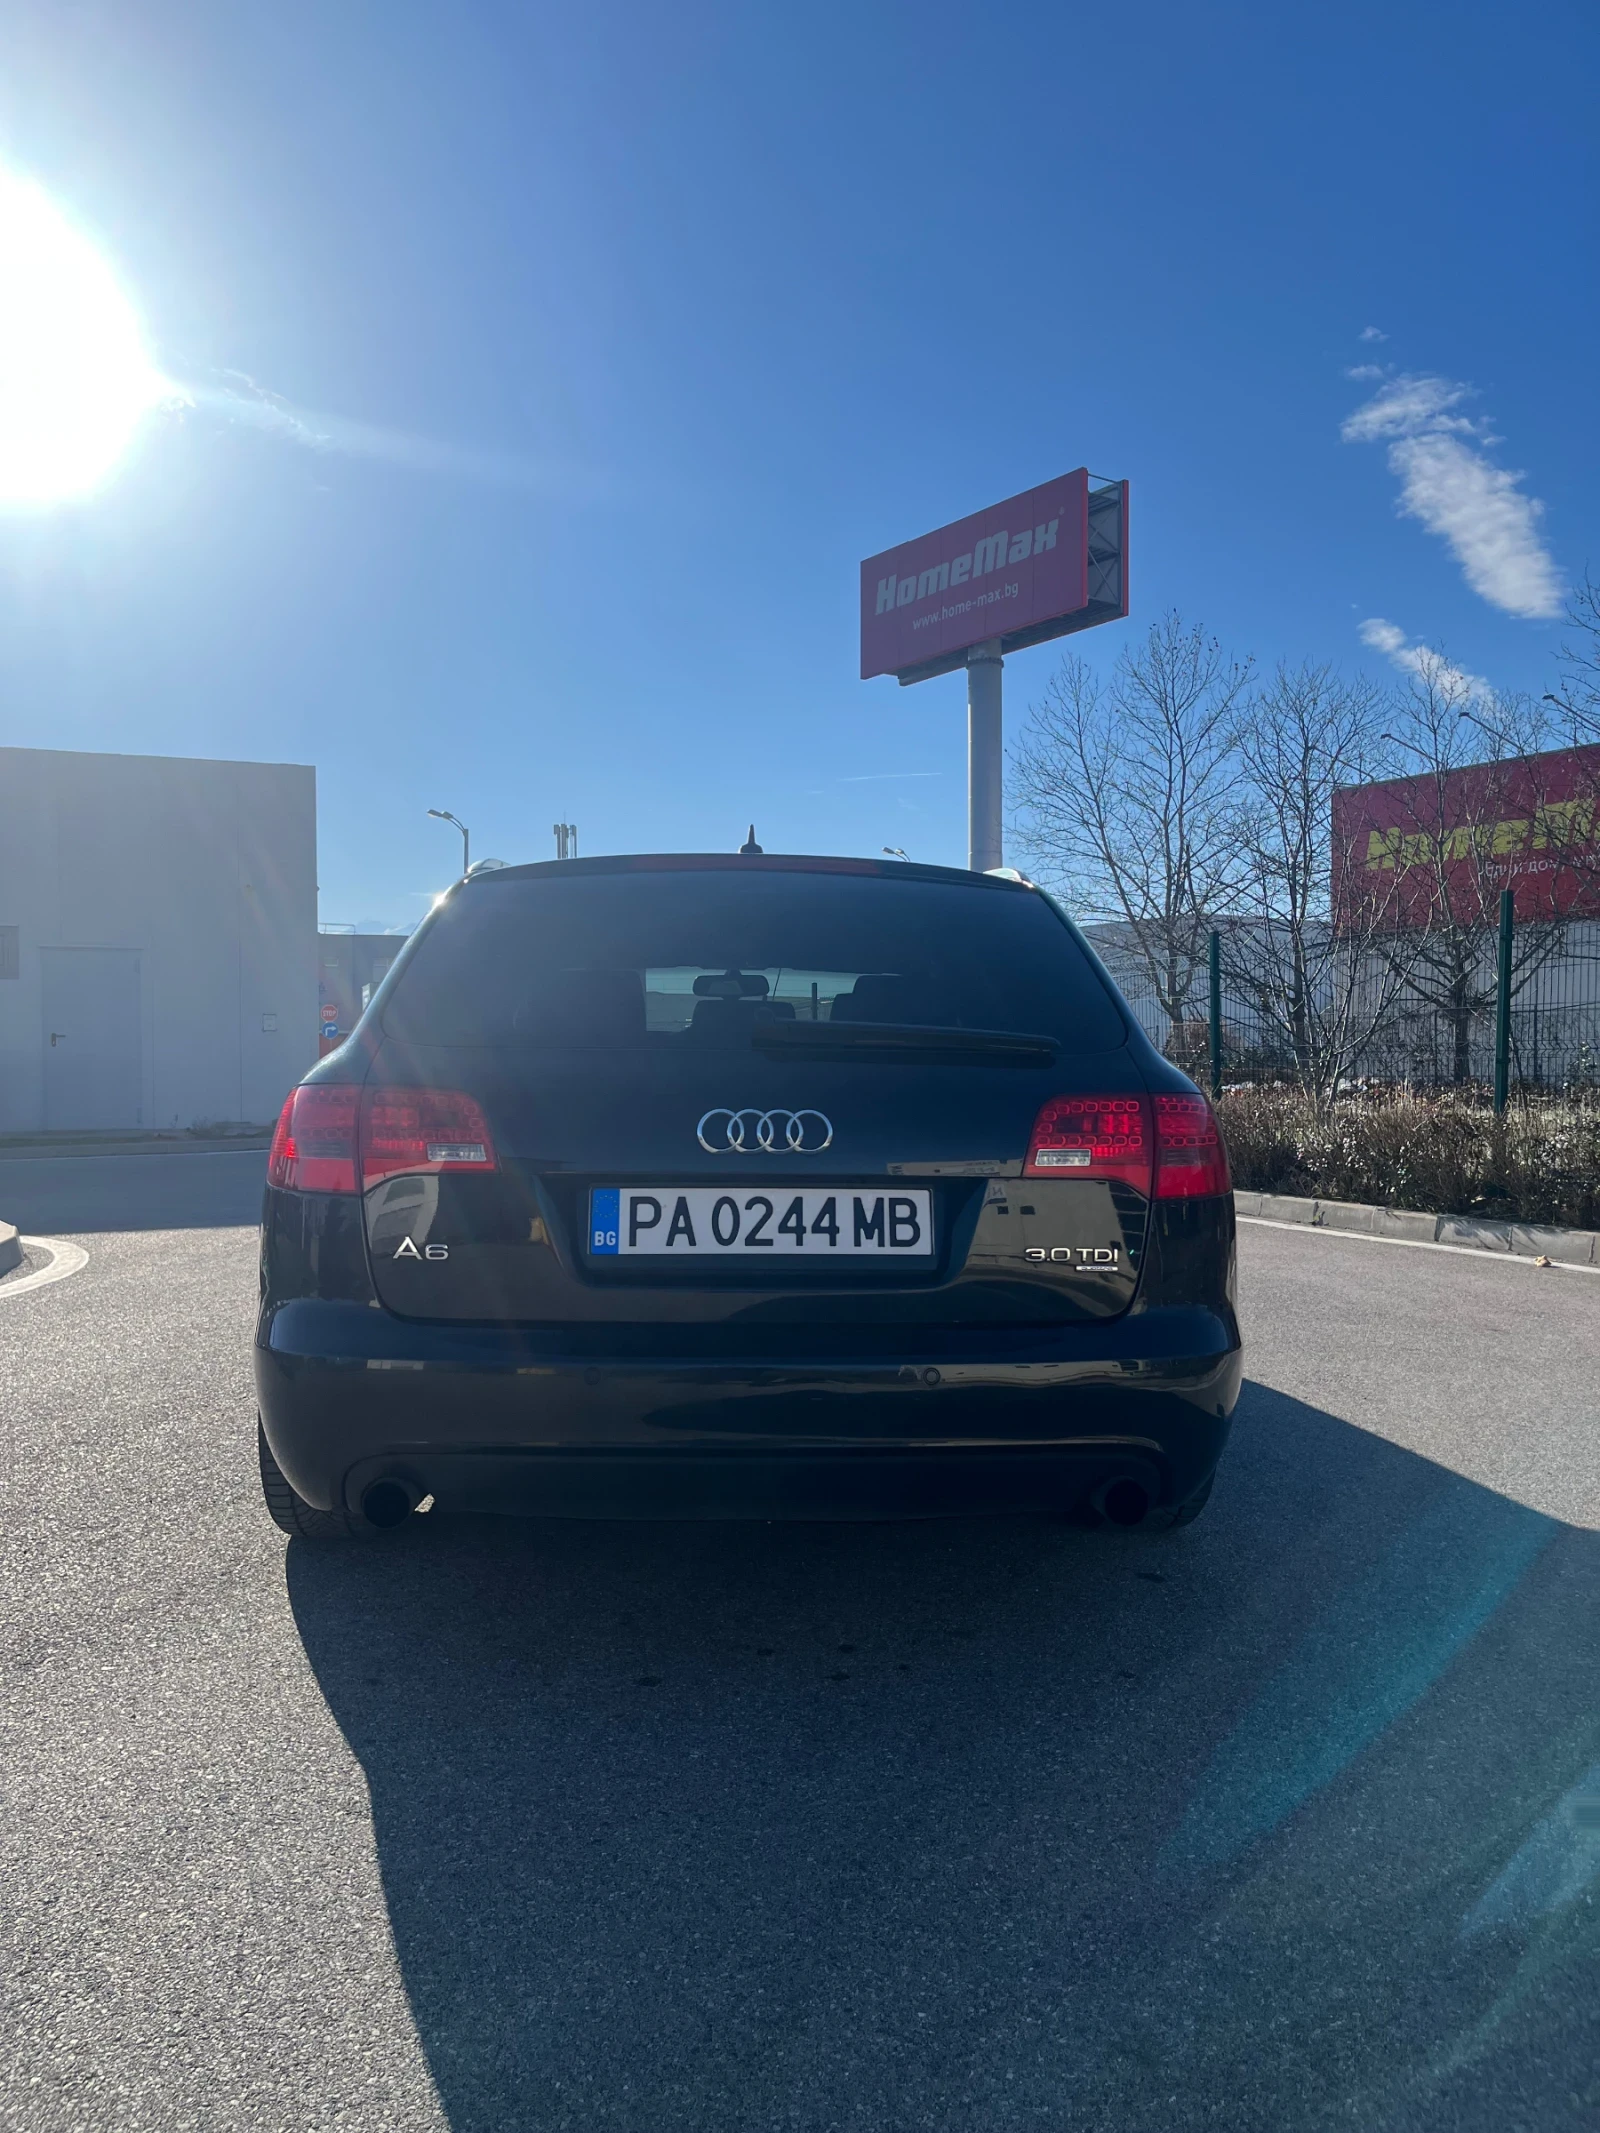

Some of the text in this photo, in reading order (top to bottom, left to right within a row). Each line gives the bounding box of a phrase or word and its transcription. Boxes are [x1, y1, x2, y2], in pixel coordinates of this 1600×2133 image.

[875, 518, 1059, 616] HomeMax
[912, 582, 1019, 630] www.home-max.bg
[322, 1009, 337, 1017] STOP
[628, 1195, 921, 1248] PA 0244 MB
[392, 1236, 449, 1260] A6
[594, 1230, 616, 1246] BG
[1025, 1247, 1119, 1263] 3.0 TDI
